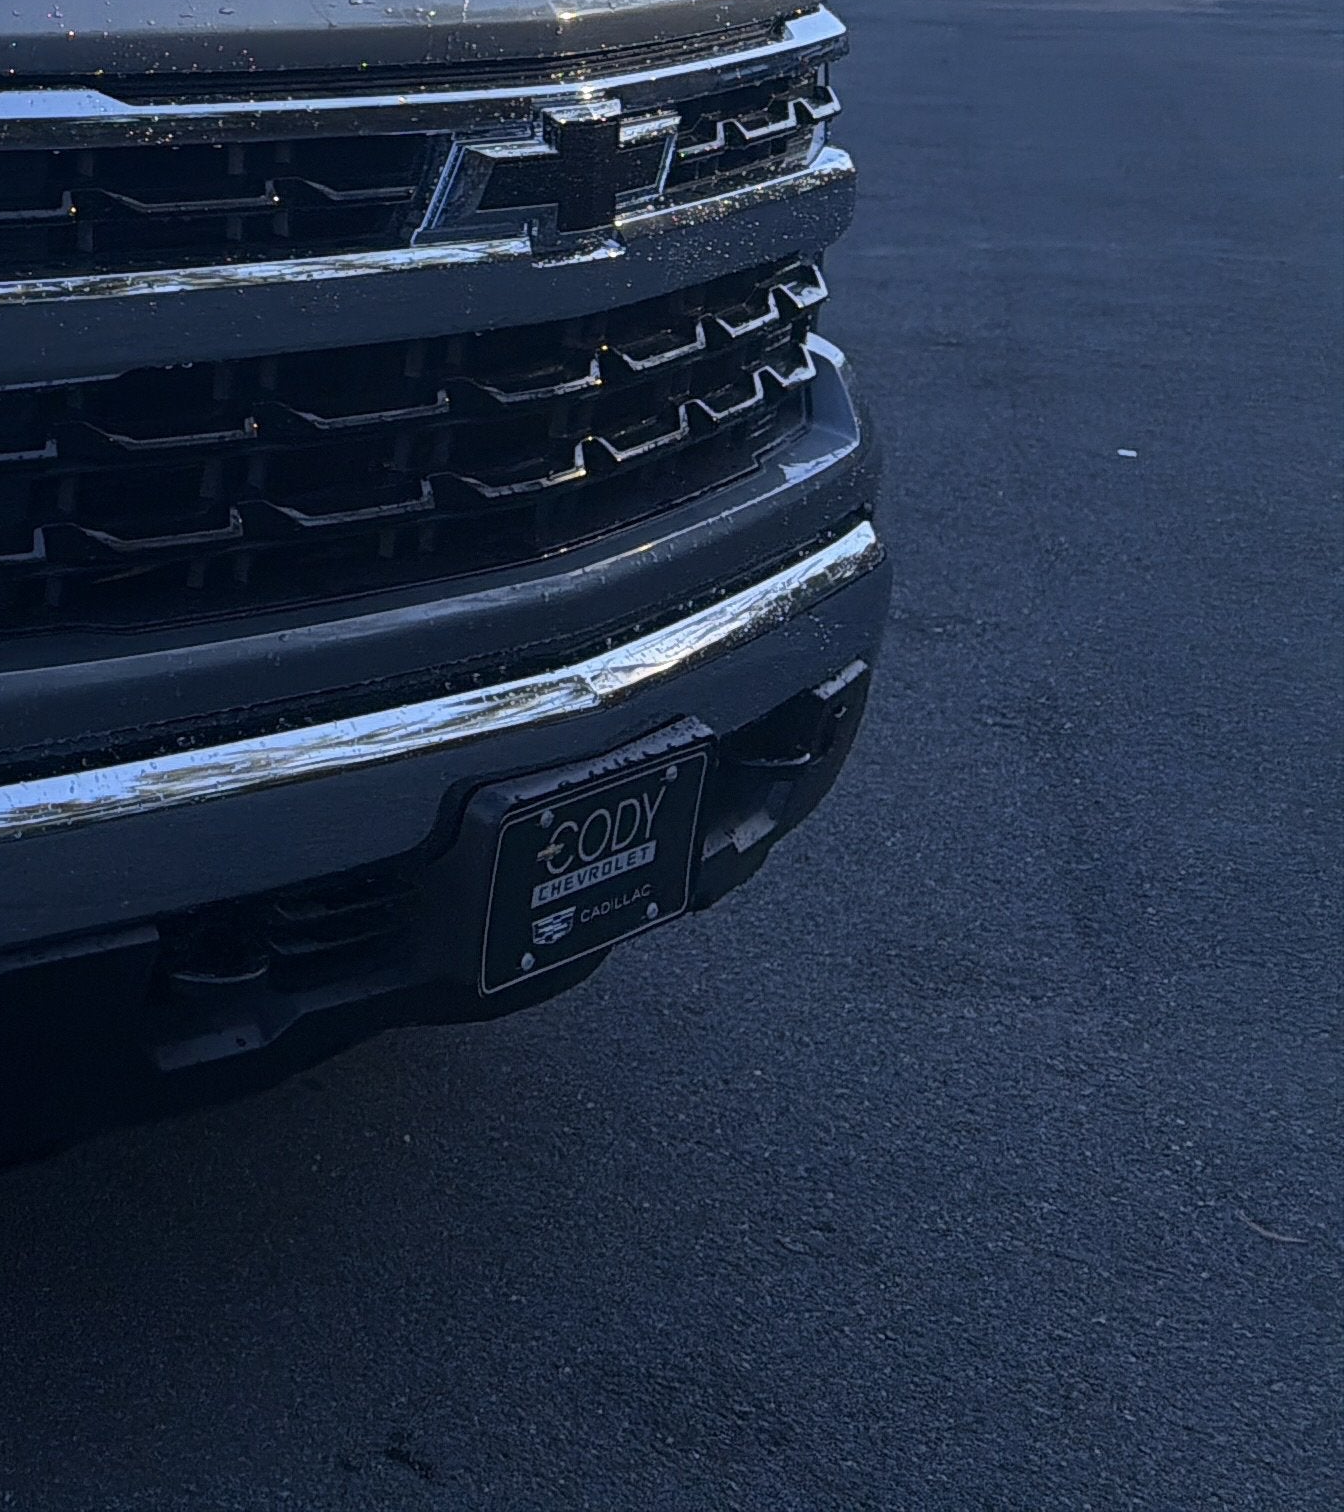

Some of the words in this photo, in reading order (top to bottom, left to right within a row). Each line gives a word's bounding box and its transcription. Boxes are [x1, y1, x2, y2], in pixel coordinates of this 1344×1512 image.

[543, 785, 667, 875] CODY
[536, 844, 651, 902] CHEVROLET
[579, 883, 654, 924] CADILLAC
